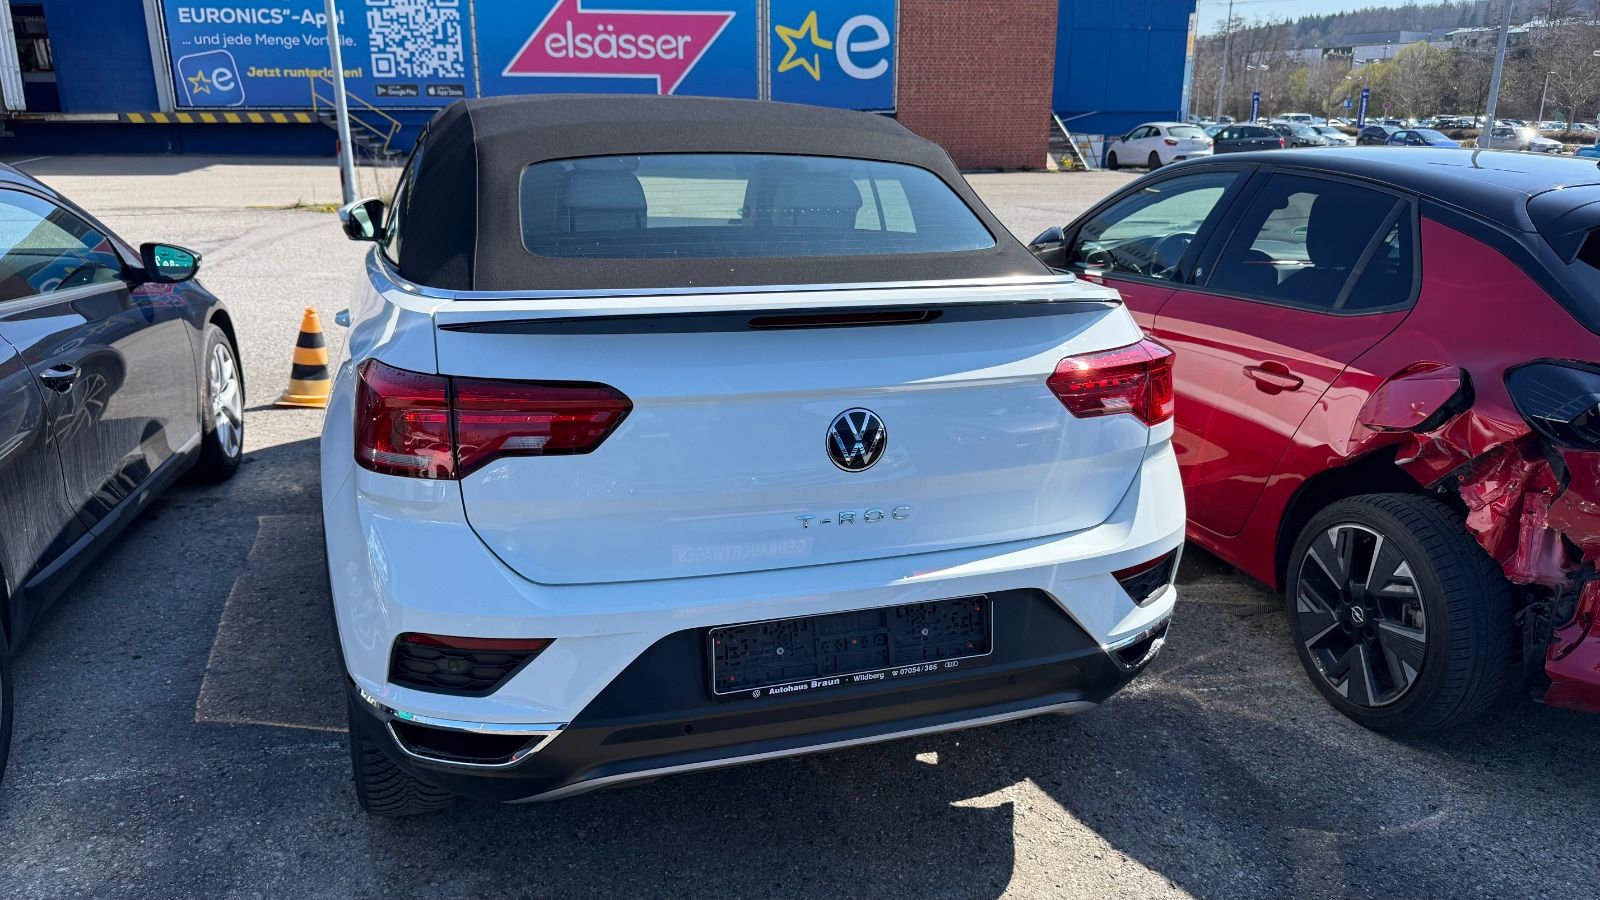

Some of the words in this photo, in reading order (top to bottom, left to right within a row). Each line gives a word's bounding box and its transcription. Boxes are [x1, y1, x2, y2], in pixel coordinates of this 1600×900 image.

[194, 33, 220, 45] und
[223, 34, 252, 48] jede
[255, 34, 300, 49] Menge
[302, 34, 357, 47] Vortile.
[544, 20, 692, 61] elsässer
[247, 66, 281, 77] Jetzt
[796, 505, 911, 529] T-ROC
[769, 682, 808, 695] Autohaus
[810, 678, 840, 688] Braun
[853, 671, 885, 682] Wildberg
[899, 663, 938, 676] 07054/365
